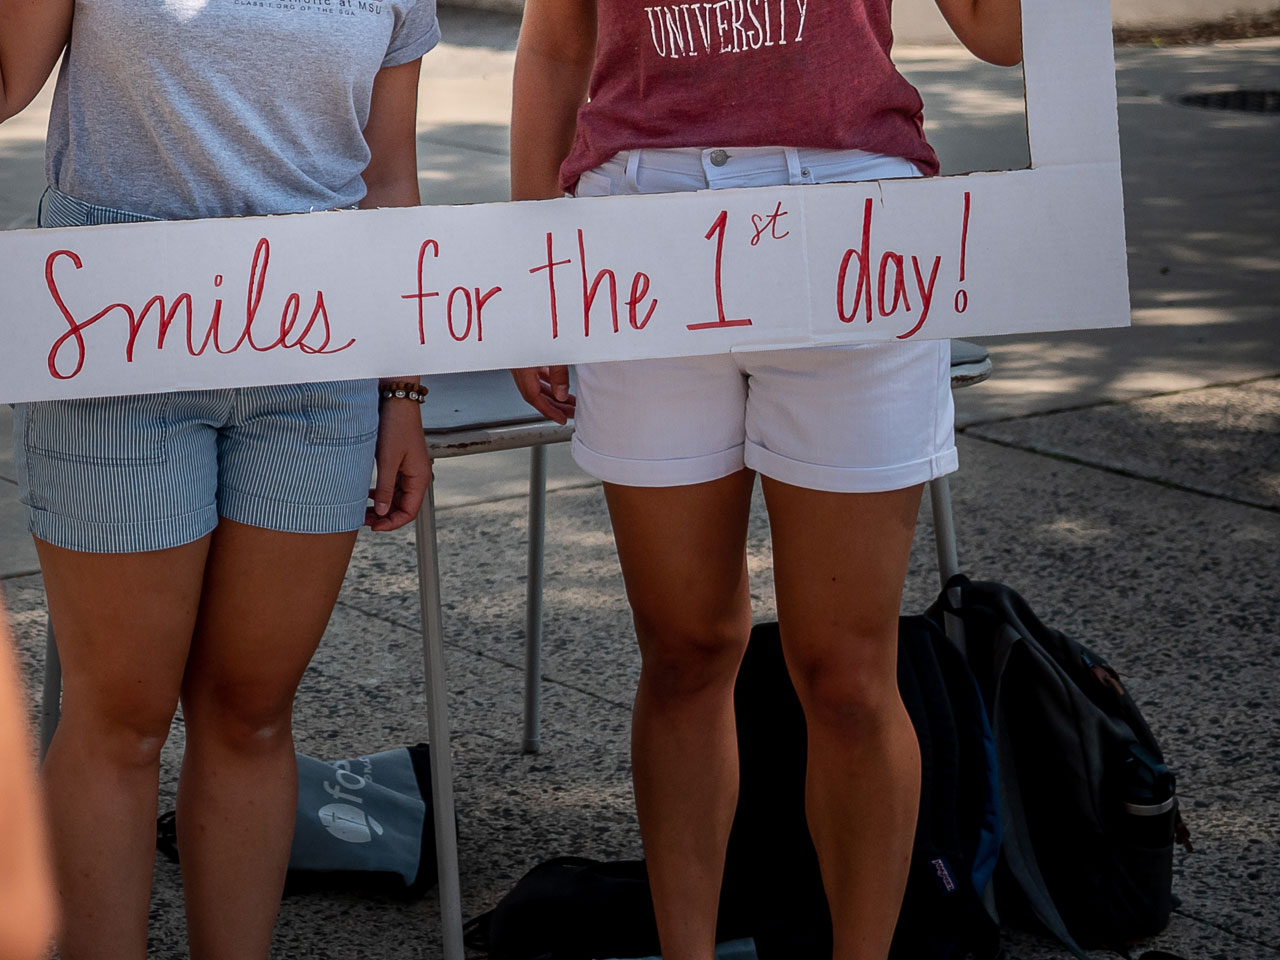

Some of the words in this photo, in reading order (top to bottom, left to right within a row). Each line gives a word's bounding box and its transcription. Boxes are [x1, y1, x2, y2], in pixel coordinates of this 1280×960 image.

[339, 0, 352, 8] at
[358, 1, 382, 15] MSU
[45, 237, 357, 380] Smiles
[400, 239, 503, 345] for
[529, 228, 658, 340] the
[836, 191, 971, 340] day!
